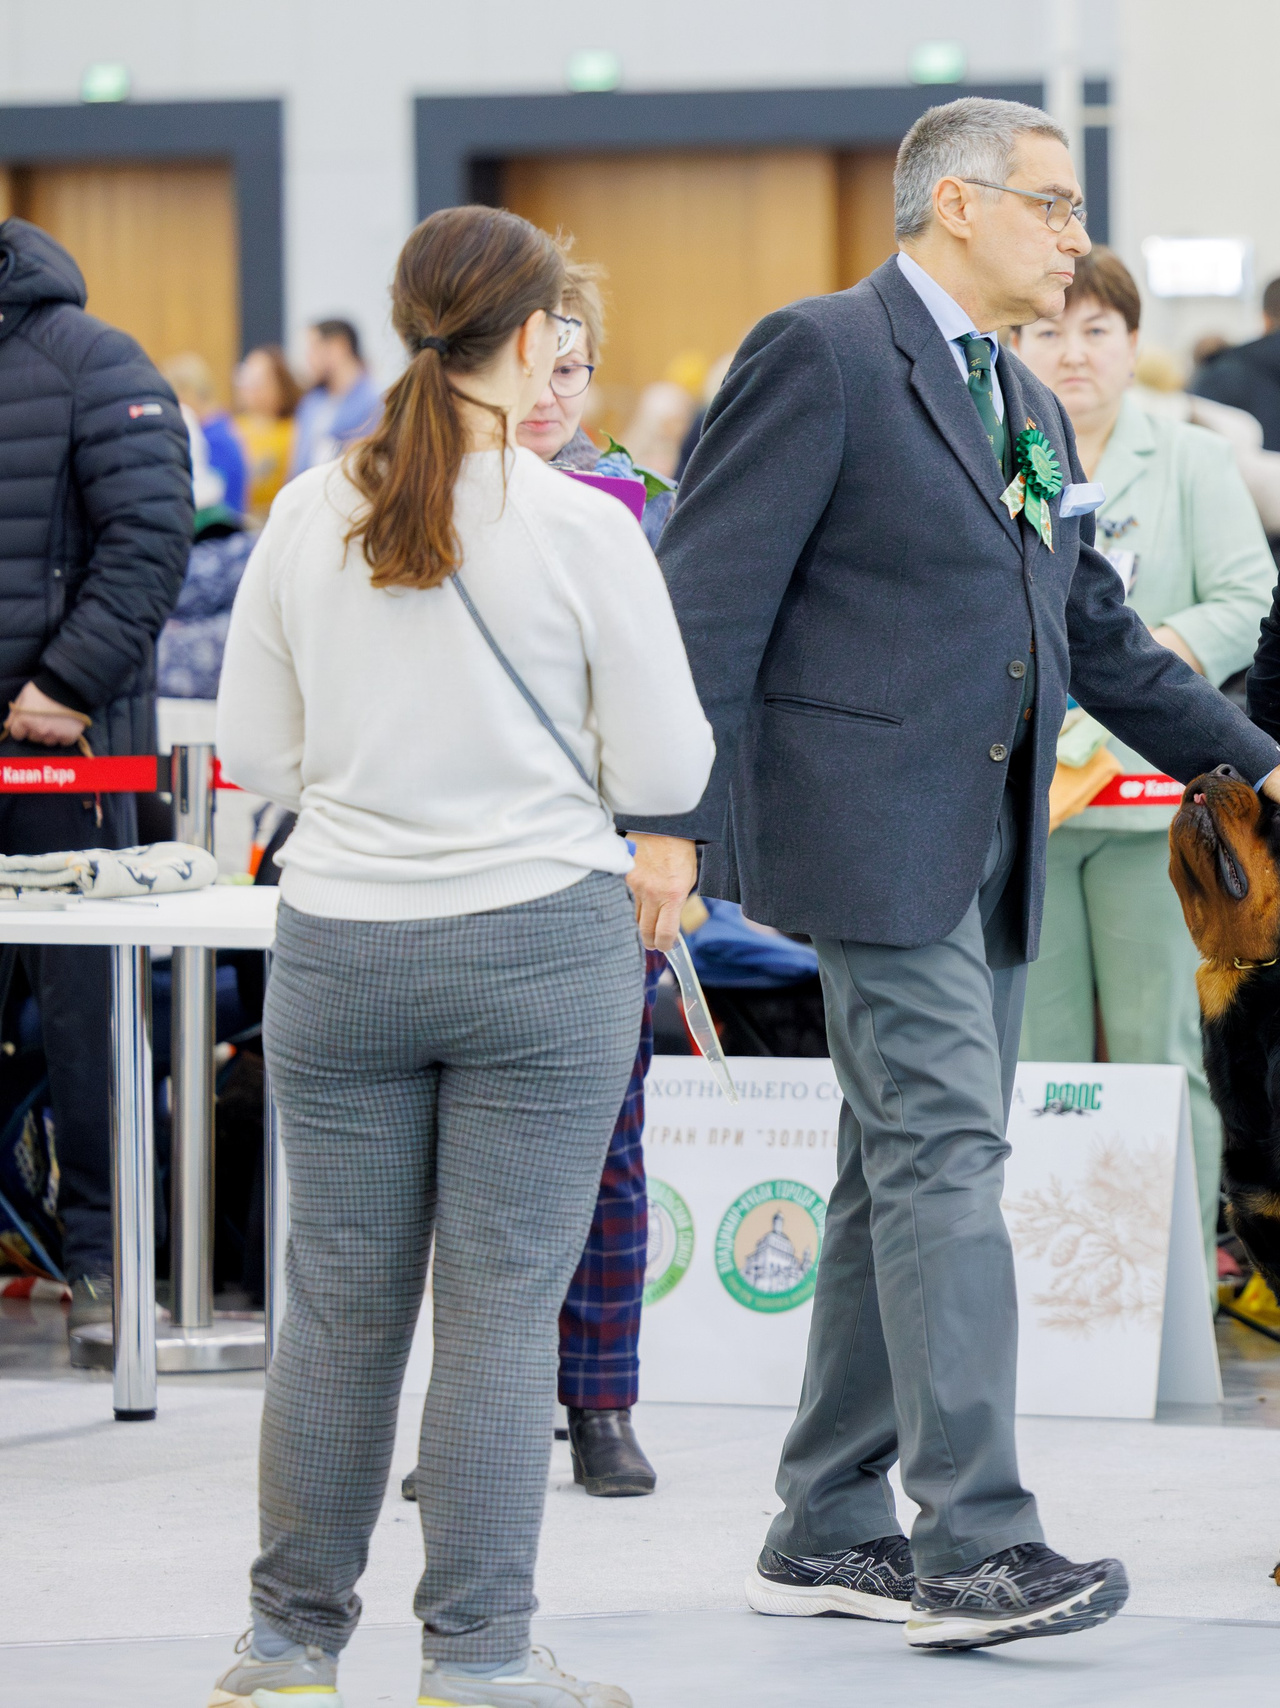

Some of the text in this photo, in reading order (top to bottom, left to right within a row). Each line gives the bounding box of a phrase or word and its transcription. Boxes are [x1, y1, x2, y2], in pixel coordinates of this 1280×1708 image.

[3, 765, 76, 788] Kazan Expo
[645, 1079, 809, 1099] ХОТНЧЬЕГО
[649, 1126, 697, 1145] ГРАН
[708, 1129, 745, 1146] ПРИ
